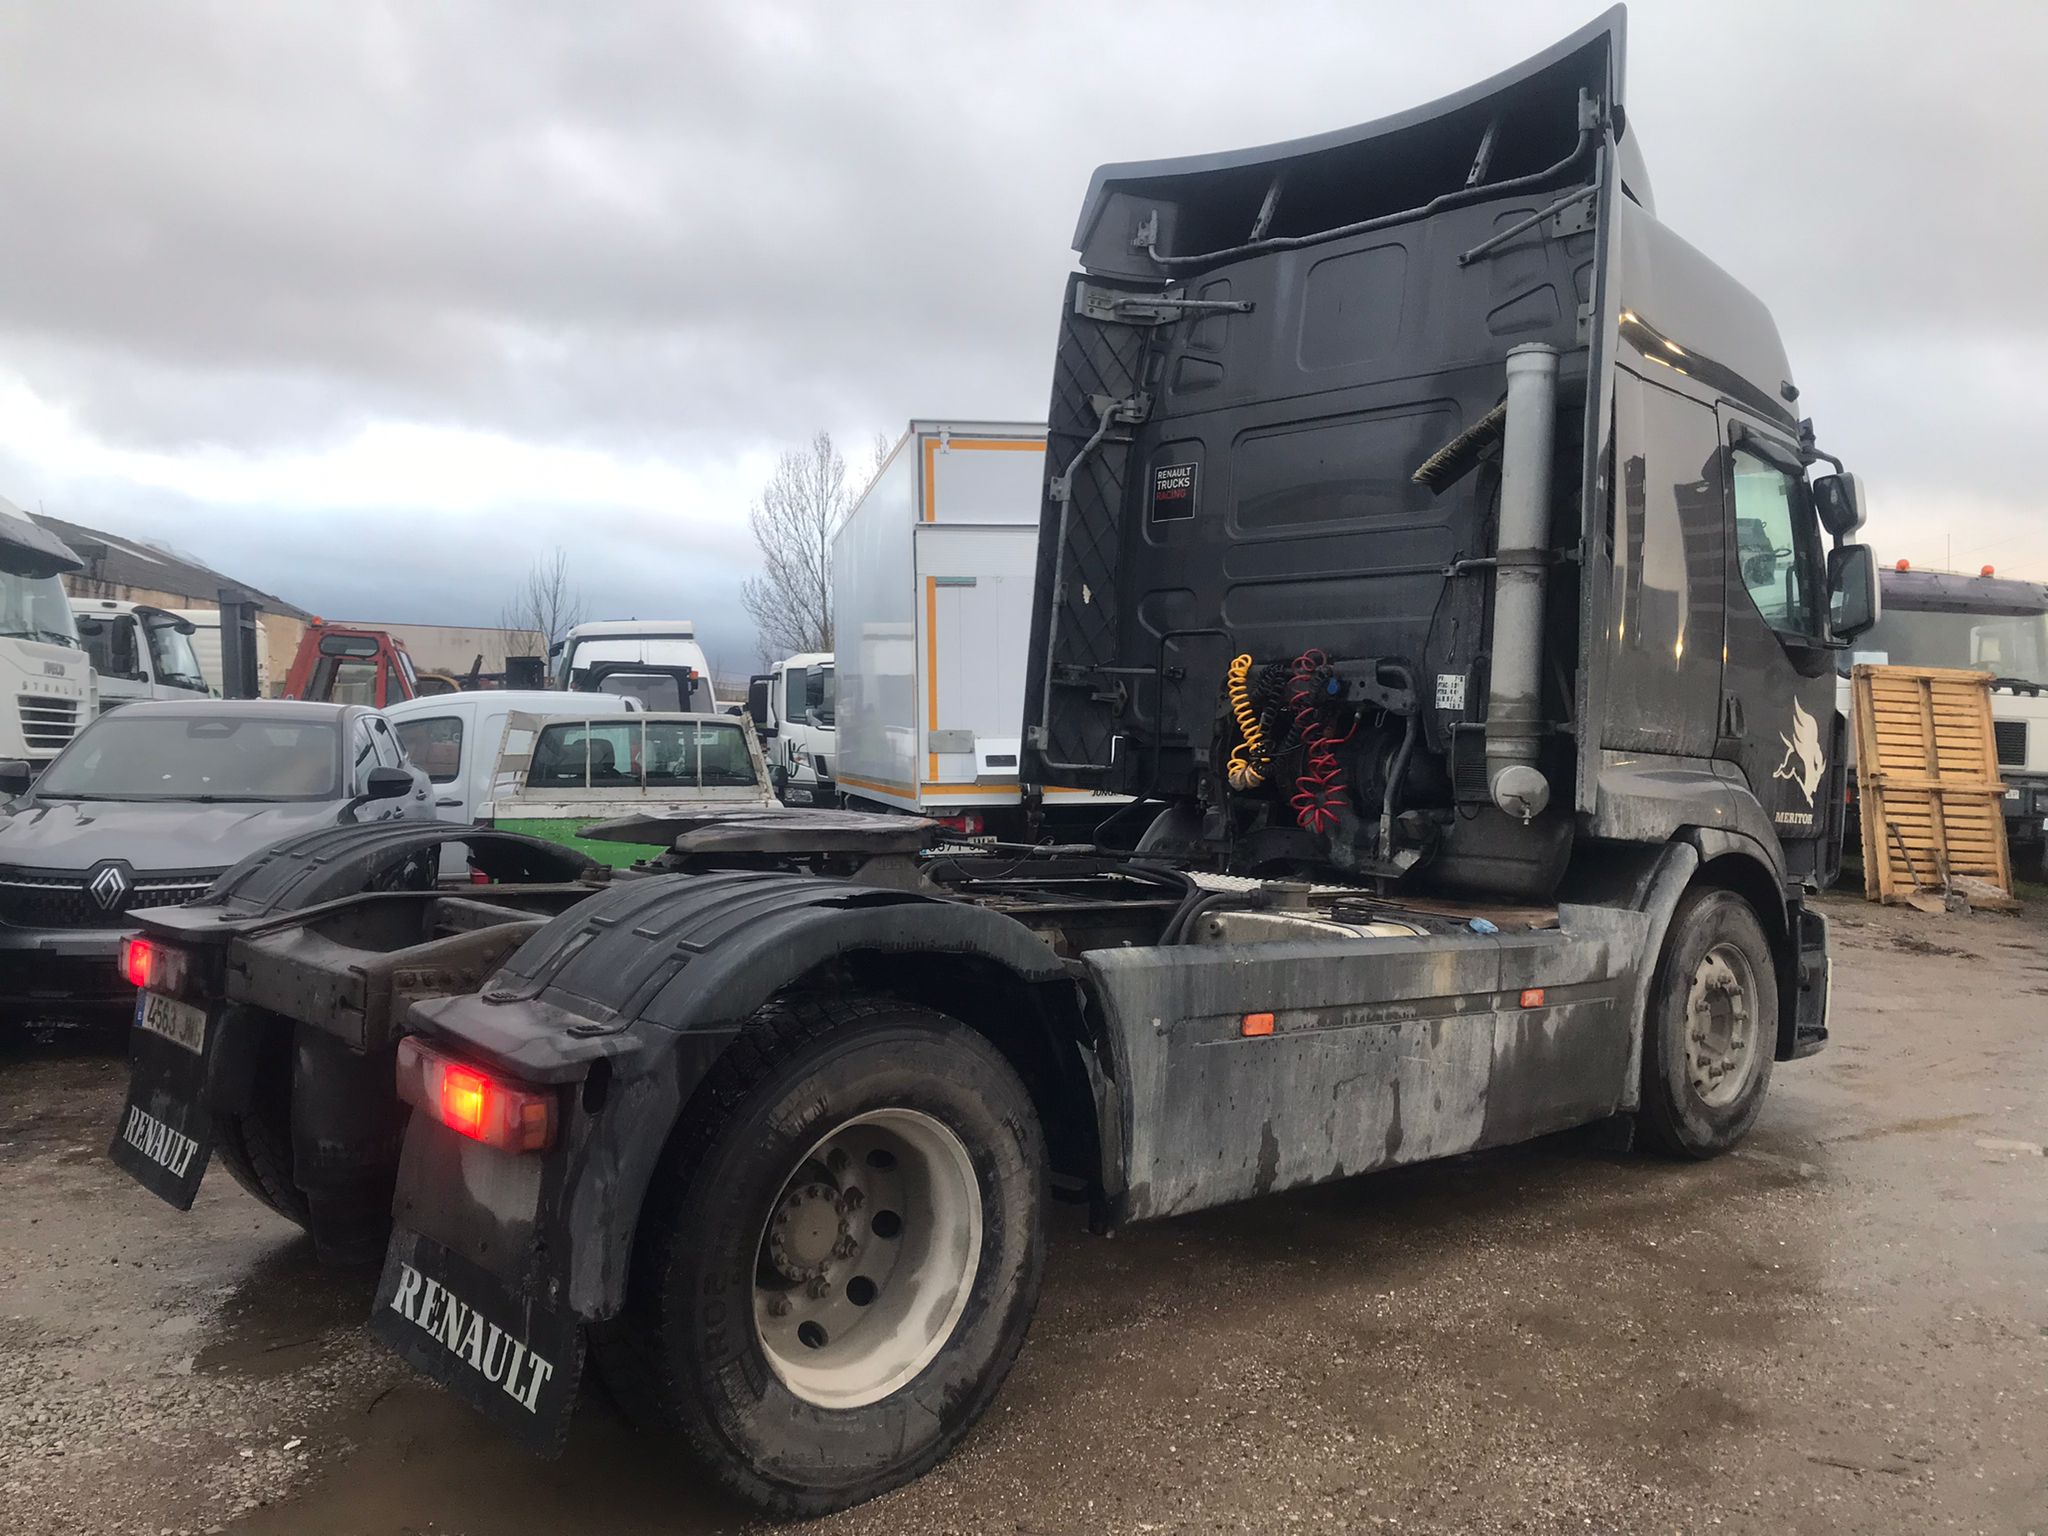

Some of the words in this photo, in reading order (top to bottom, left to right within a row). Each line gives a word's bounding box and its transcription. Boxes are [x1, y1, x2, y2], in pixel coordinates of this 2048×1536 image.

[1157, 466, 1191, 480] RENAULT
[1157, 477, 1190, 490] TRUCKS
[1774, 811, 1813, 825] MERITOR
[147, 996, 177, 1036] 4563
[123, 1104, 199, 1179] RENAULT
[390, 1261, 554, 1415] RENAULT
